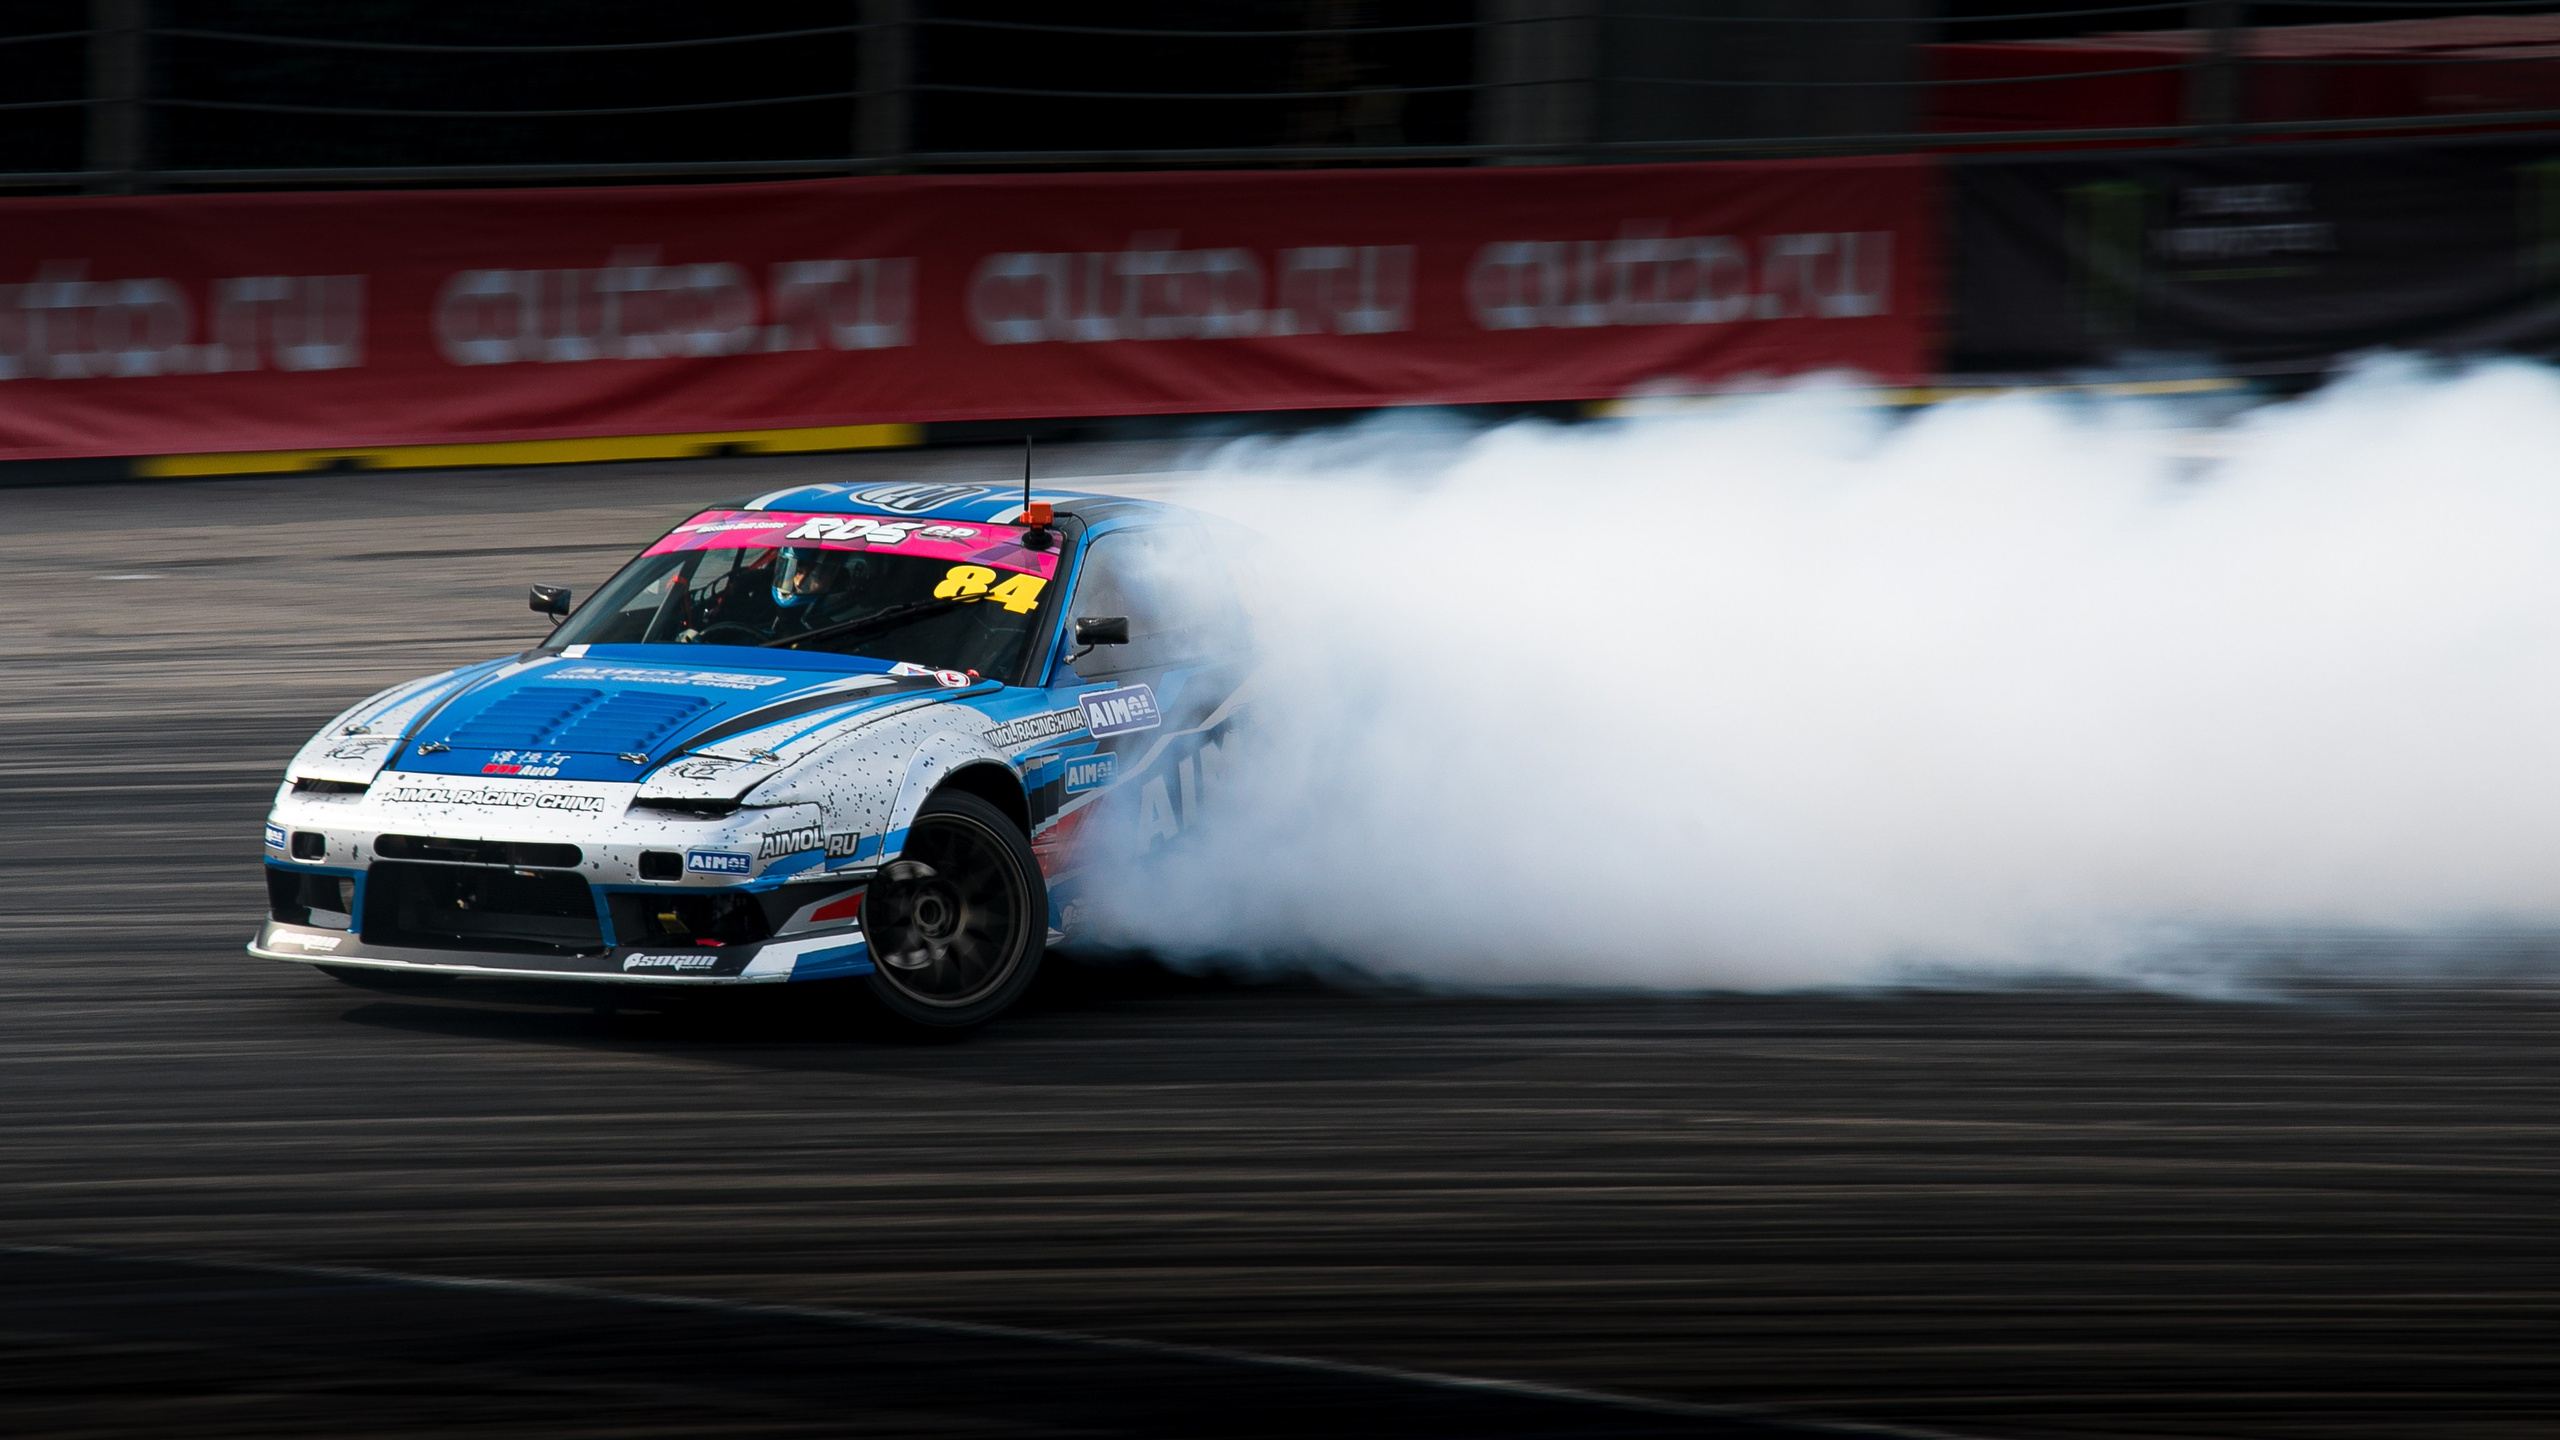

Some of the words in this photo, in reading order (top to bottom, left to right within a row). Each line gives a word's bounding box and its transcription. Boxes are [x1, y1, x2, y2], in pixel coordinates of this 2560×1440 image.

[786, 517, 926, 544] RDS
[933, 565, 1048, 614] 84
[692, 681, 757, 690] CHINA
[1015, 714, 1057, 741] RACING
[1055, 708, 1087, 734] HINA
[1088, 694, 1156, 729] AIMOL
[1067, 760, 1112, 787] AIMOL
[384, 787, 451, 804] AIMOL
[452, 789, 537, 808] RACING
[536, 794, 605, 812] CHINA
[689, 854, 749, 871] AIMOL
